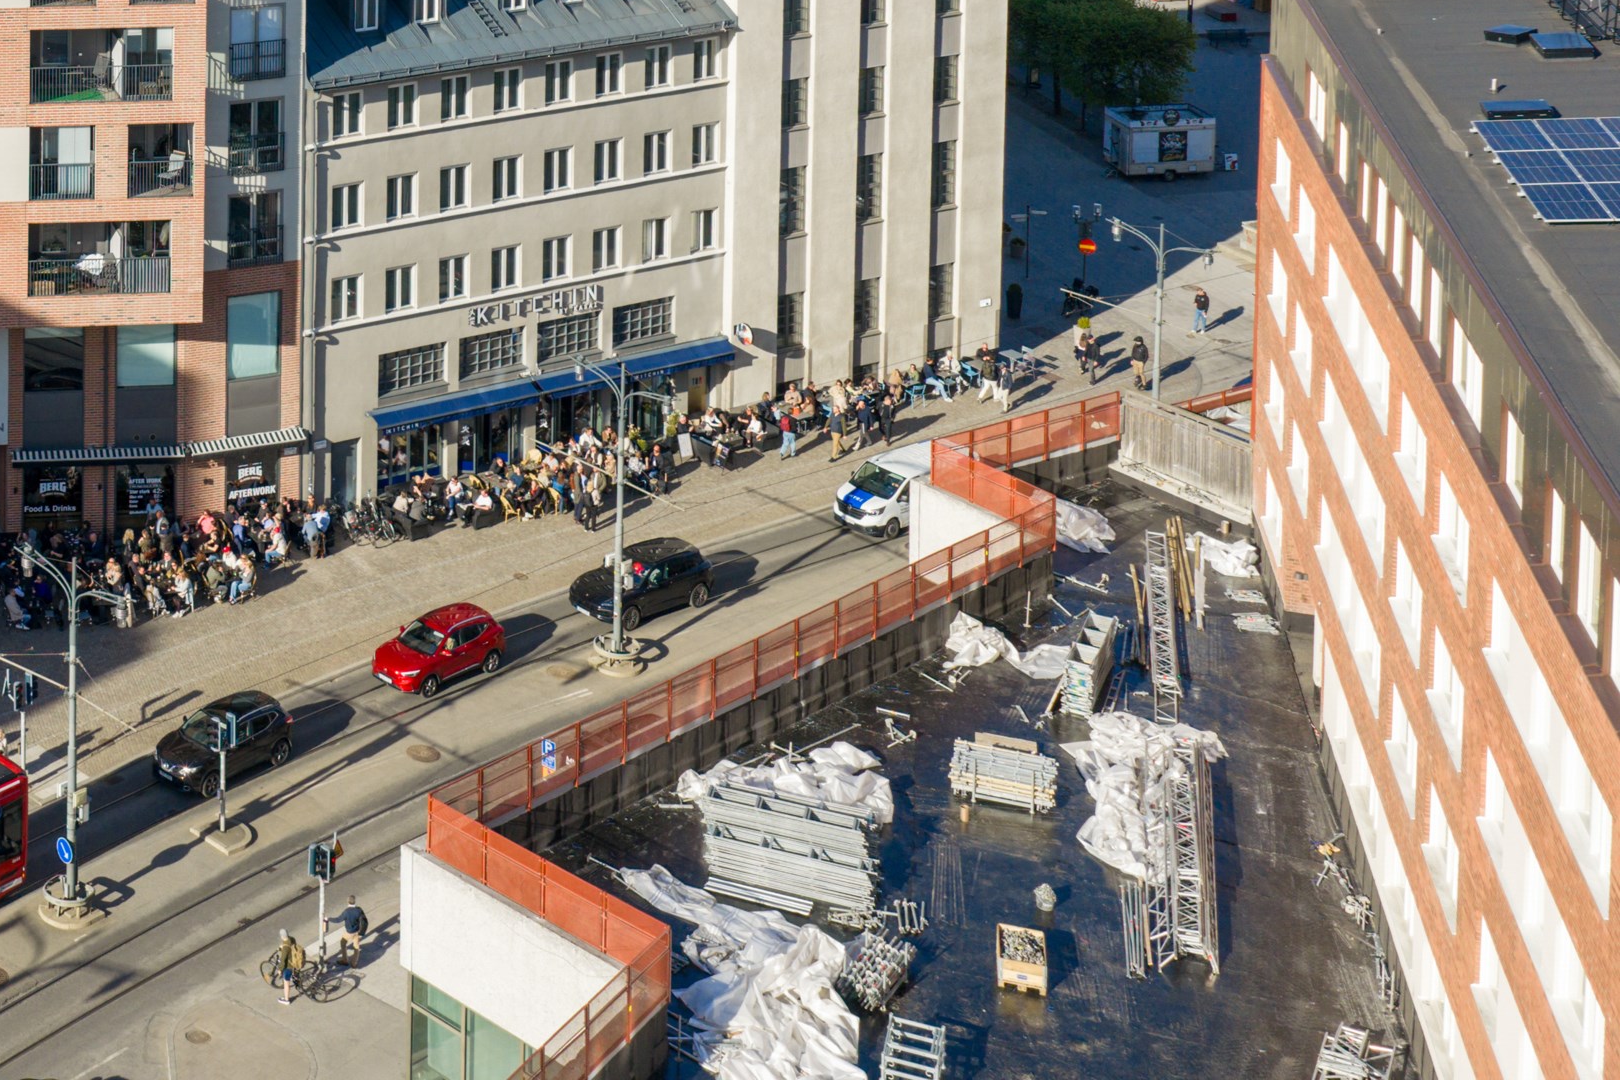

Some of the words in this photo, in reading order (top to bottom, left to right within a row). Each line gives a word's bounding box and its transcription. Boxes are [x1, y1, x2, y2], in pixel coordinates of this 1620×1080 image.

[477, 284, 597, 324] KITCHIN
[388, 423, 419, 434] KITCHIN
[237, 466, 262, 480] BERG
[39, 481, 67, 494] BERG
[24, 505, 42, 513] Food
[52, 504, 77, 512] Drinks
